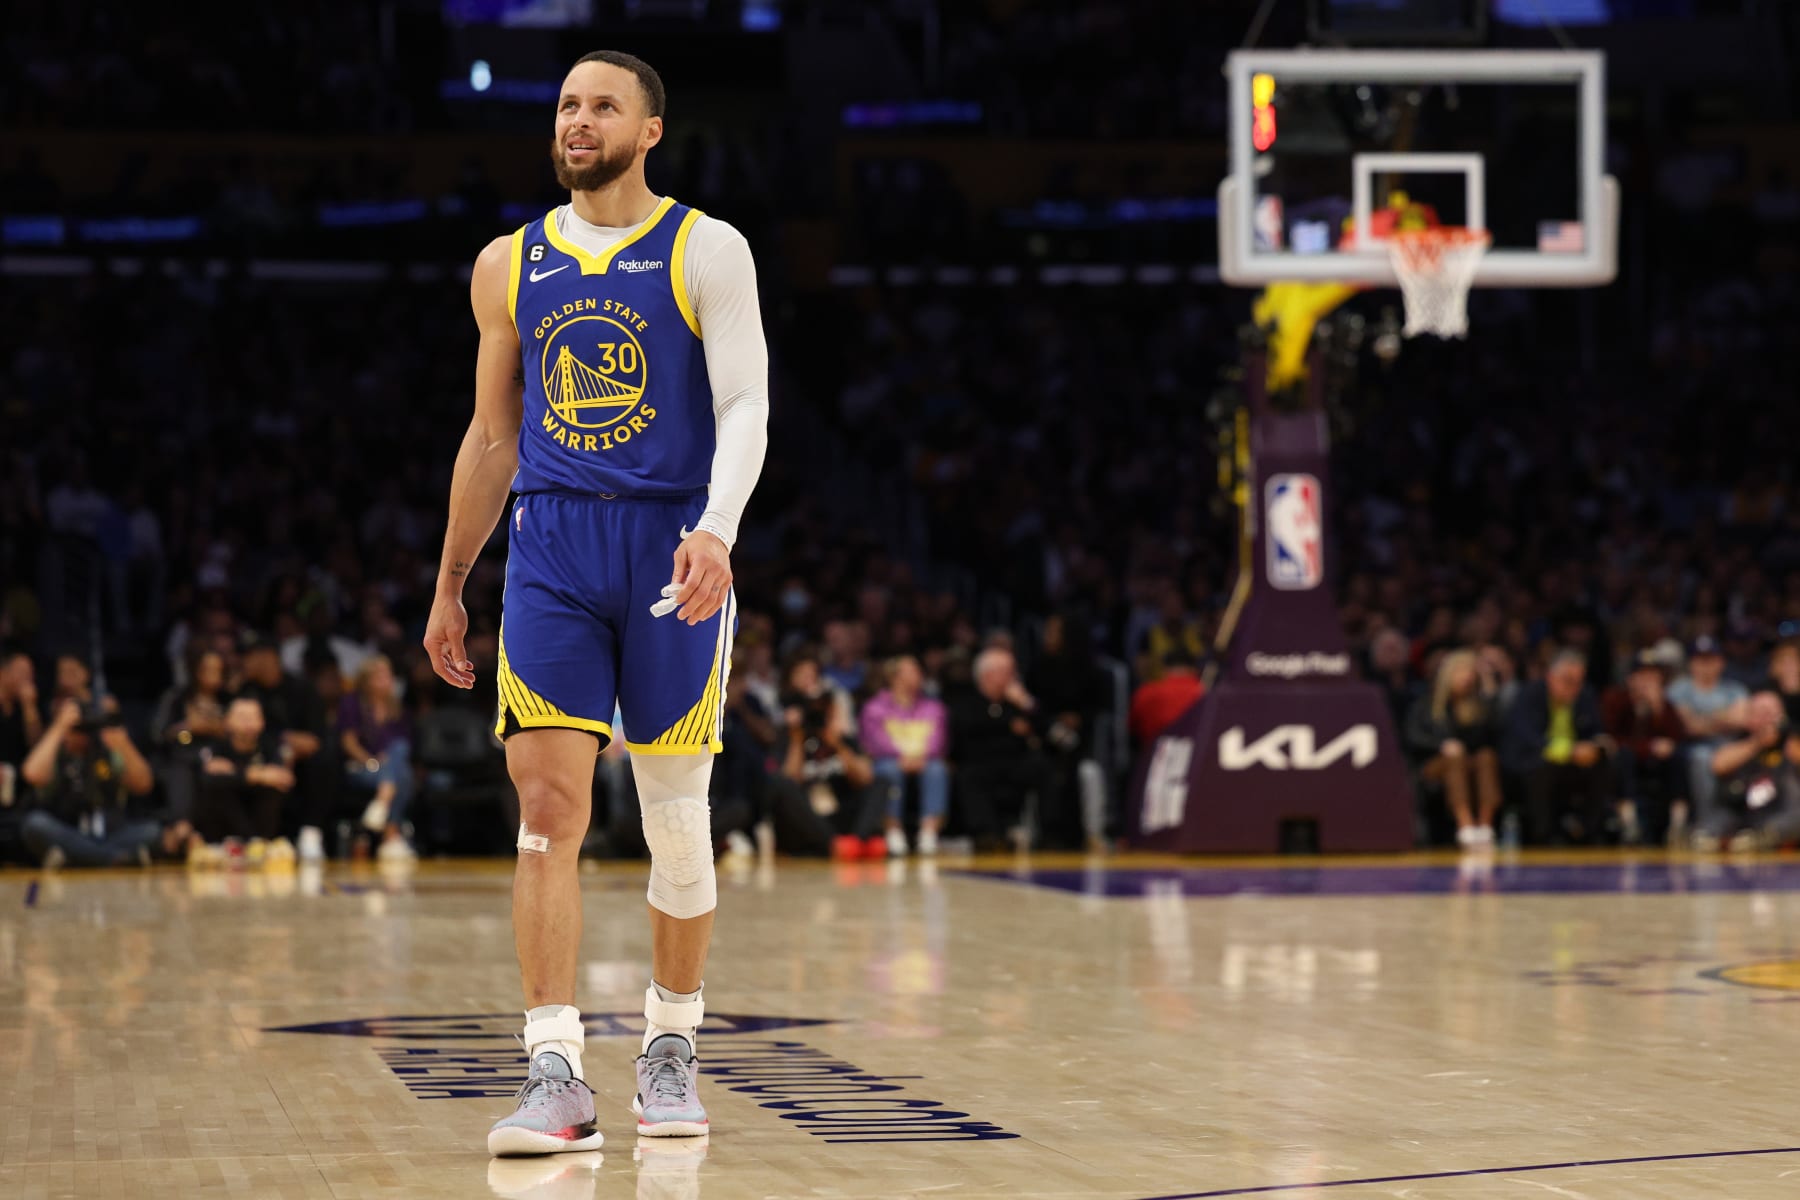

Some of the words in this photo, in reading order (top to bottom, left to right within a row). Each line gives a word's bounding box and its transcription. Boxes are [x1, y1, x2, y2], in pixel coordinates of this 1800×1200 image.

[529, 245, 545, 261] 6
[617, 260, 663, 272] Rakuten
[534, 298, 596, 340] GOLDEN
[603, 299, 648, 332] STATE
[597, 342, 637, 375] 30
[542, 403, 657, 452] WARRIORS
[1218, 724, 1378, 770] KIA
